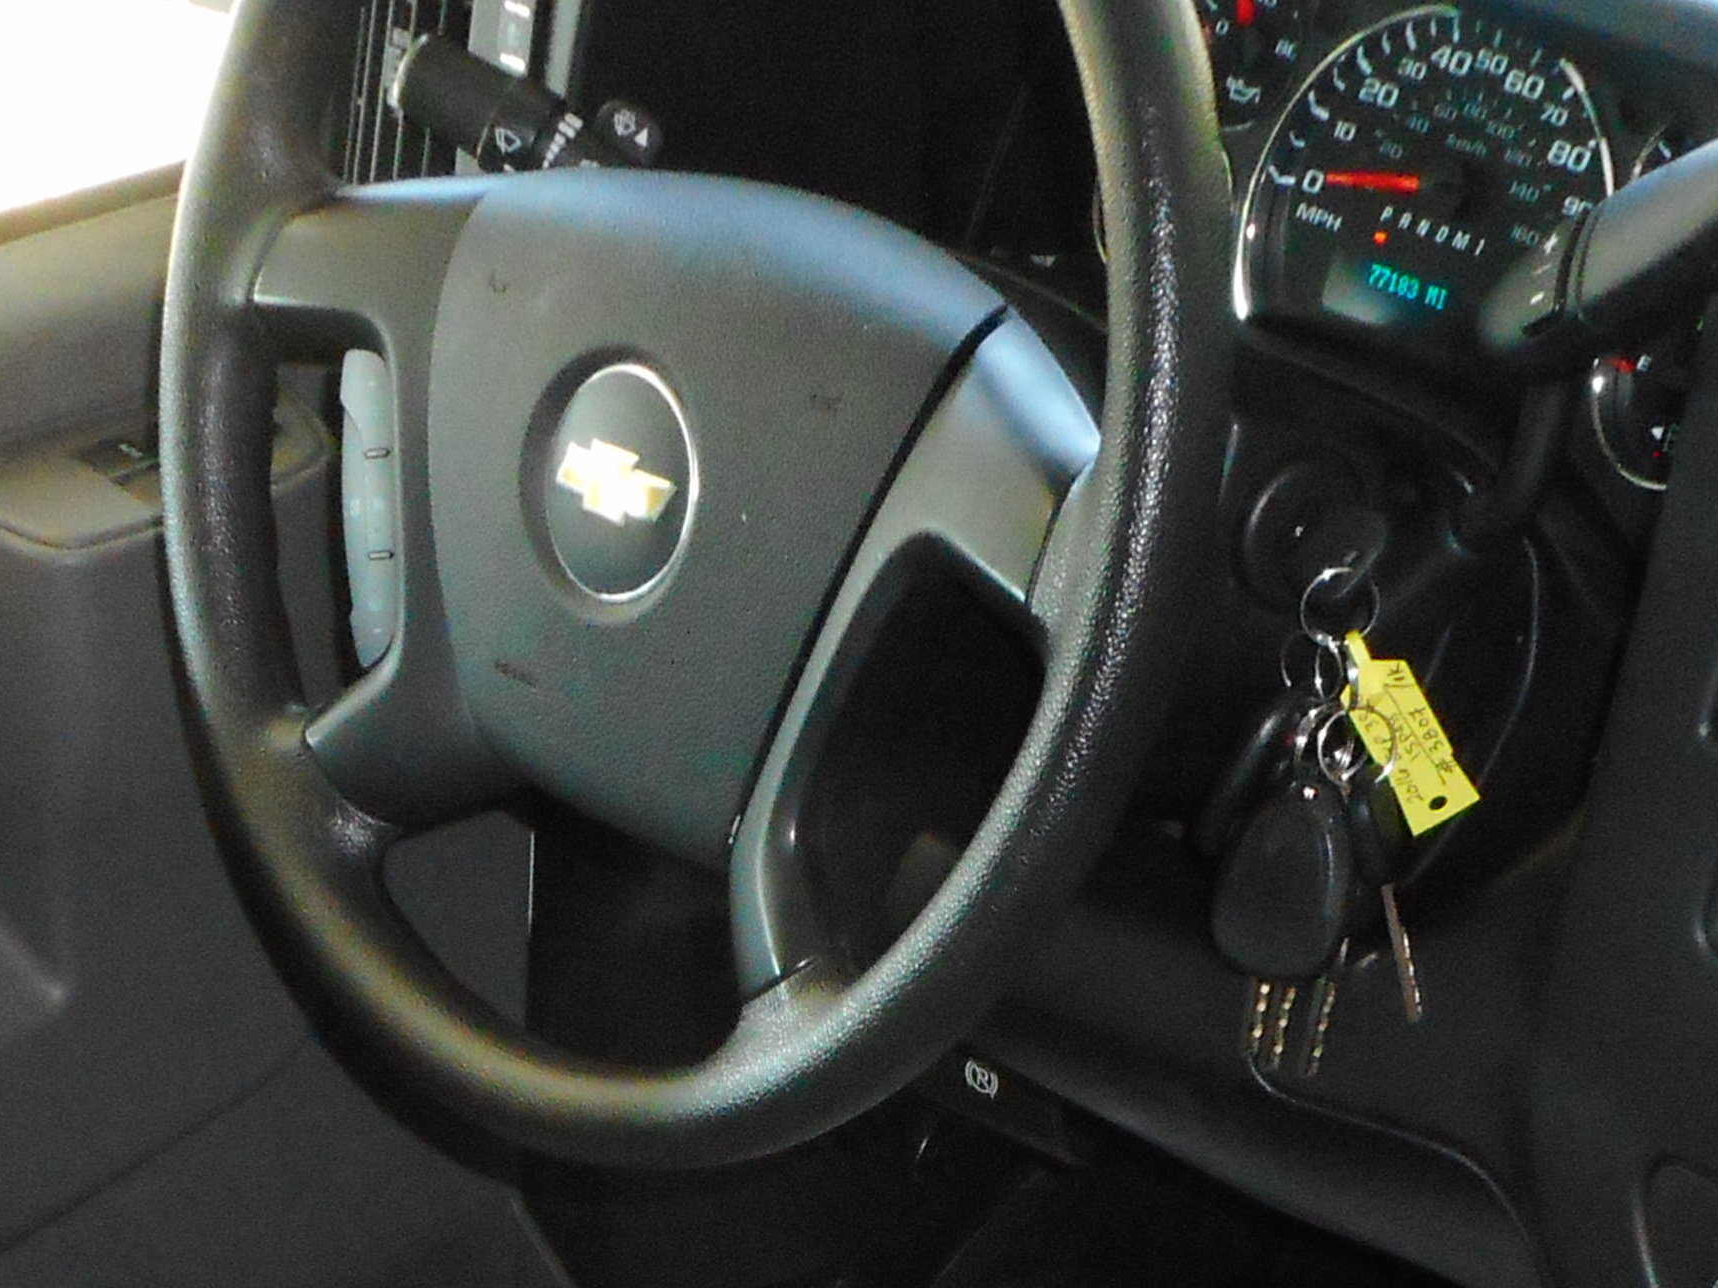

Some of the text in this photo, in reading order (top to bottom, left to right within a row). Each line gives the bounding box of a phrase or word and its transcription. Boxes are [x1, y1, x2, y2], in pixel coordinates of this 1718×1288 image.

[1397, 57, 1428, 81] 30
[1431, 44, 1473, 77] 40
[1474, 48, 1509, 76] 50
[1358, 77, 1400, 108] 20
[1503, 68, 1545, 100] 60
[1540, 102, 1569, 127] 70
[1334, 121, 1357, 142] 10
[1547, 139, 1591, 173] 80
[1301, 168, 1325, 195] 0
[1295, 202, 1343, 233] MPH
[1368, 263, 1448, 311] 77183 MI
